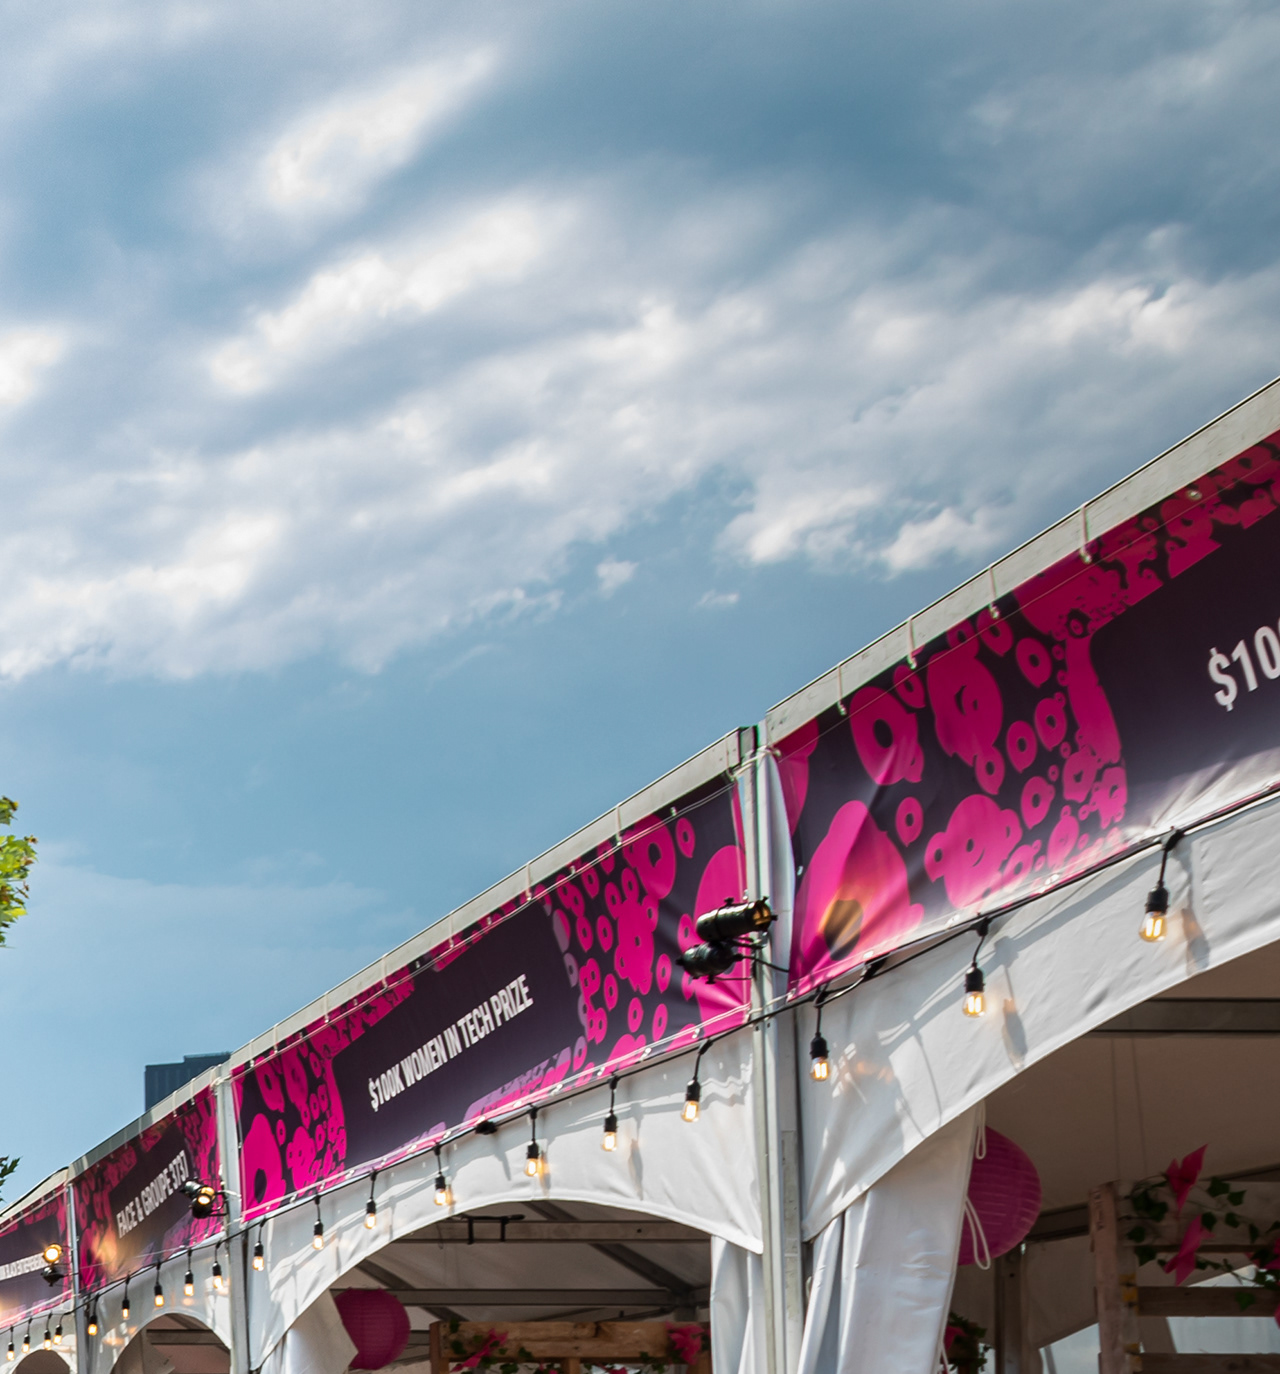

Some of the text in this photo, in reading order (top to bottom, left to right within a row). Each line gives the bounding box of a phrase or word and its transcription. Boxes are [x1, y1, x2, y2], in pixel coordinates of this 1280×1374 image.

[1207, 616, 1280, 713] $10
[368, 973, 534, 1113] $100K WOMEN IN TECH PRIZE
[116, 1201, 138, 1239] FACE
[134, 1196, 145, 1223] &
[140, 1167, 174, 1217] GROUPE
